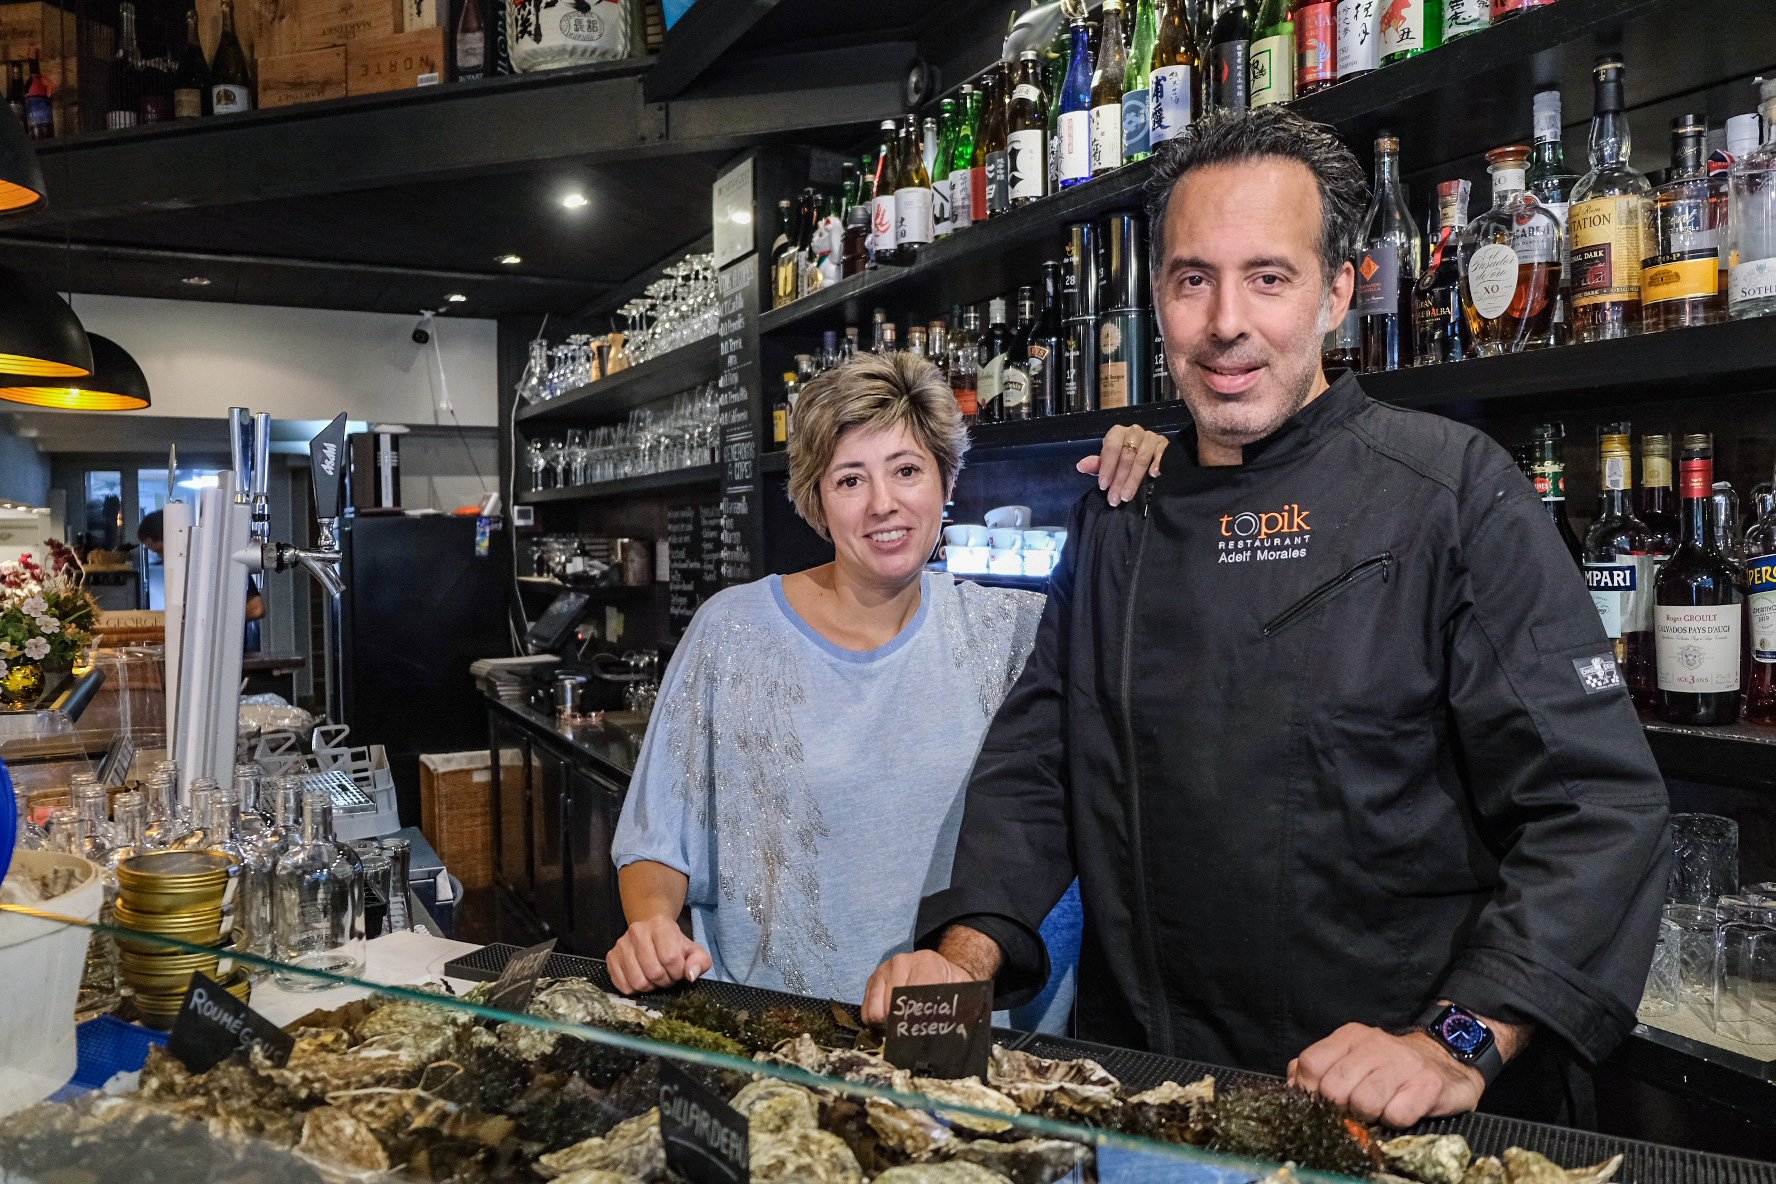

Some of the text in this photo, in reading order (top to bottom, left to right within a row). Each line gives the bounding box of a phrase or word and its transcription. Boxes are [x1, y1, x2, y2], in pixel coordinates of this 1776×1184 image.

[1584, 249, 1604, 260] DARK
[1065, 275, 1076, 286] 28
[1483, 284, 1500, 295] XO
[1741, 285, 1776, 298] SOTH
[1154, 354, 1164, 365] 12
[1066, 369, 1076, 381] 17
[1219, 503, 1311, 539] topik
[1218, 535, 1311, 550] RESTAURANT
[1218, 548, 1307, 564] Adelf Morales
[1683, 613, 1717, 622] GROULT
[1688, 625, 1707, 634] PAYS
[1688, 675, 1696, 685] 3
